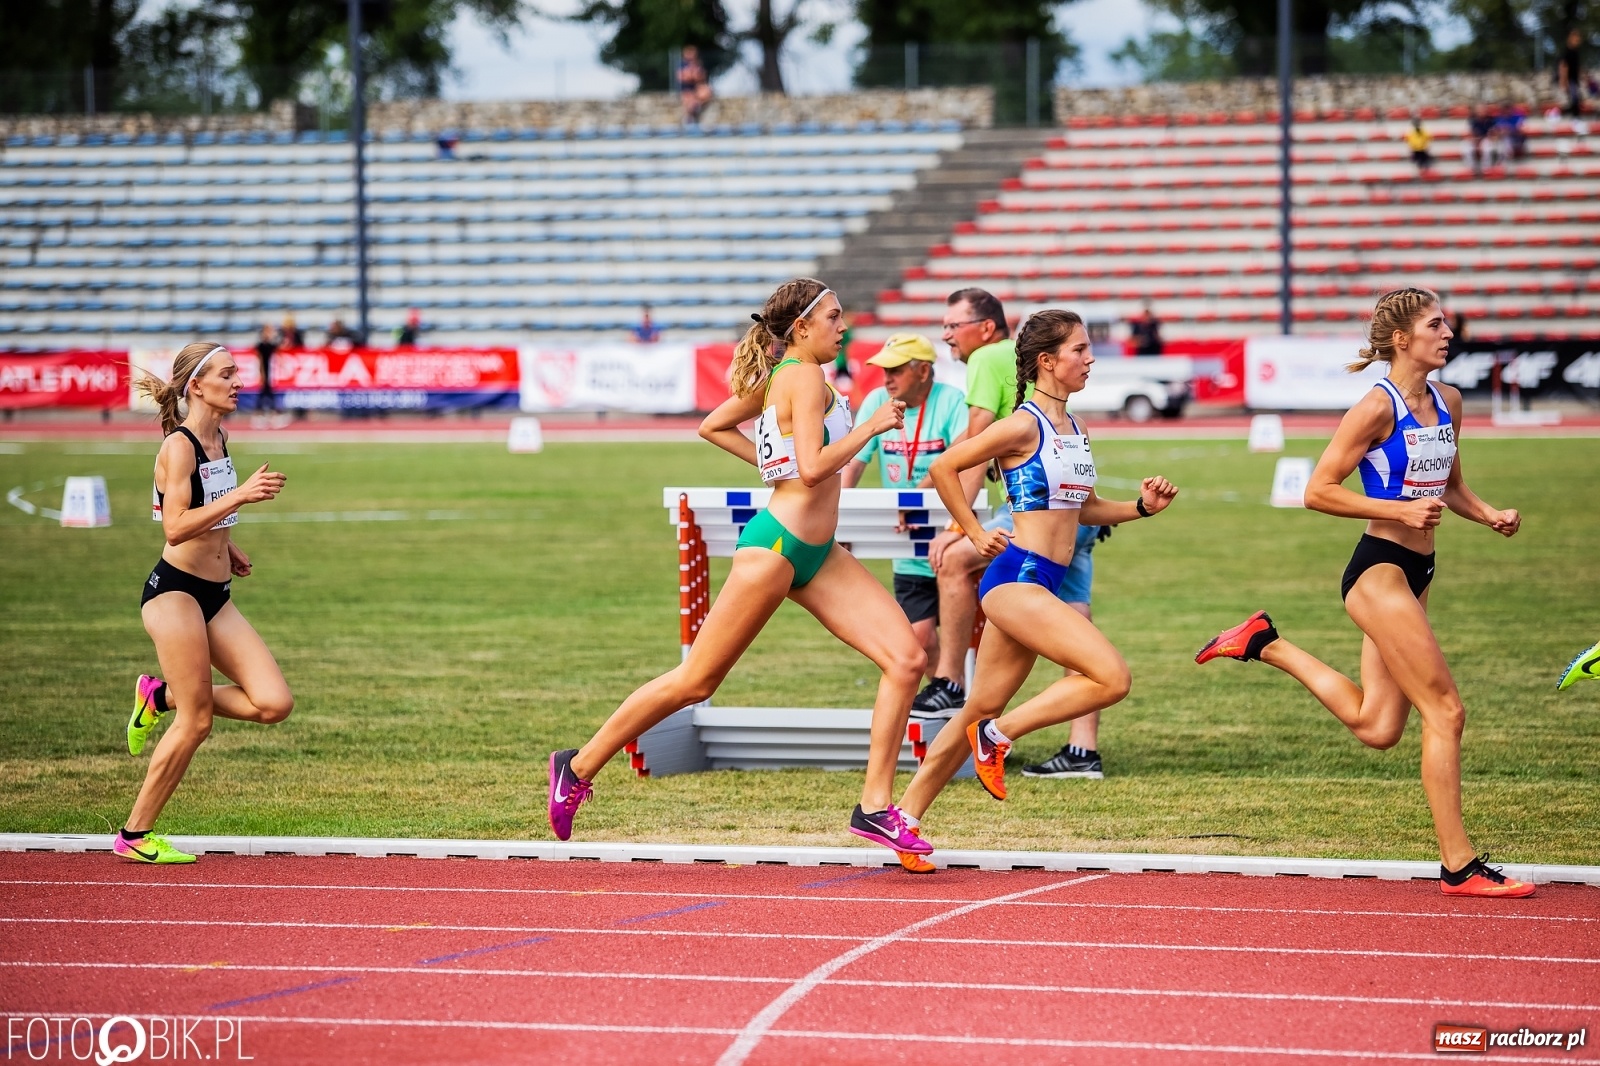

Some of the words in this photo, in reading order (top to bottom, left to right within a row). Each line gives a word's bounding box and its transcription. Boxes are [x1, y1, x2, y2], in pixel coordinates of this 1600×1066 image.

[1440, 352, 1494, 388] 4F
[1501, 351, 1558, 388] 4F
[766, 467, 782, 478] 2019
